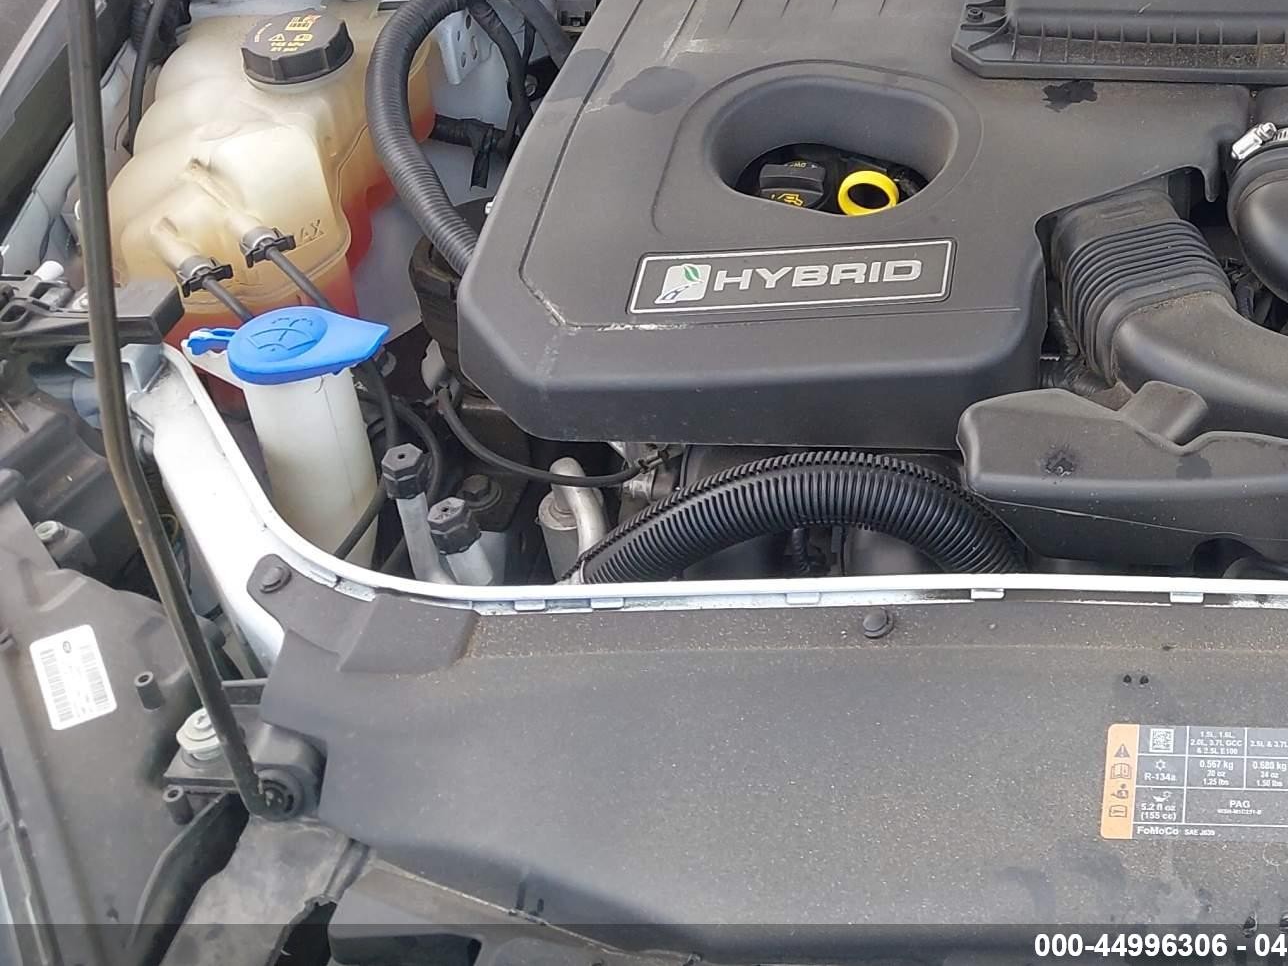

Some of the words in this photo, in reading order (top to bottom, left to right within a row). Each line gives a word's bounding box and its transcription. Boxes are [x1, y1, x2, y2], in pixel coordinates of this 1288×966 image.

[713, 259, 922, 291] HYBRID
[1223, 760, 1234, 771] kg
[1276, 761, 1288, 772] kg
[1144, 772, 1177, 782] R-134a
[1218, 778, 1230, 786] lbs
[1271, 779, 1284, 787] lbs
[1140, 802, 1155, 811] 5.2
[1229, 799, 1251, 809] PAG
[1140, 811, 1161, 821] (155
[1162, 812, 1178, 822] cc)
[1136, 825, 1179, 835] FoMoCo
